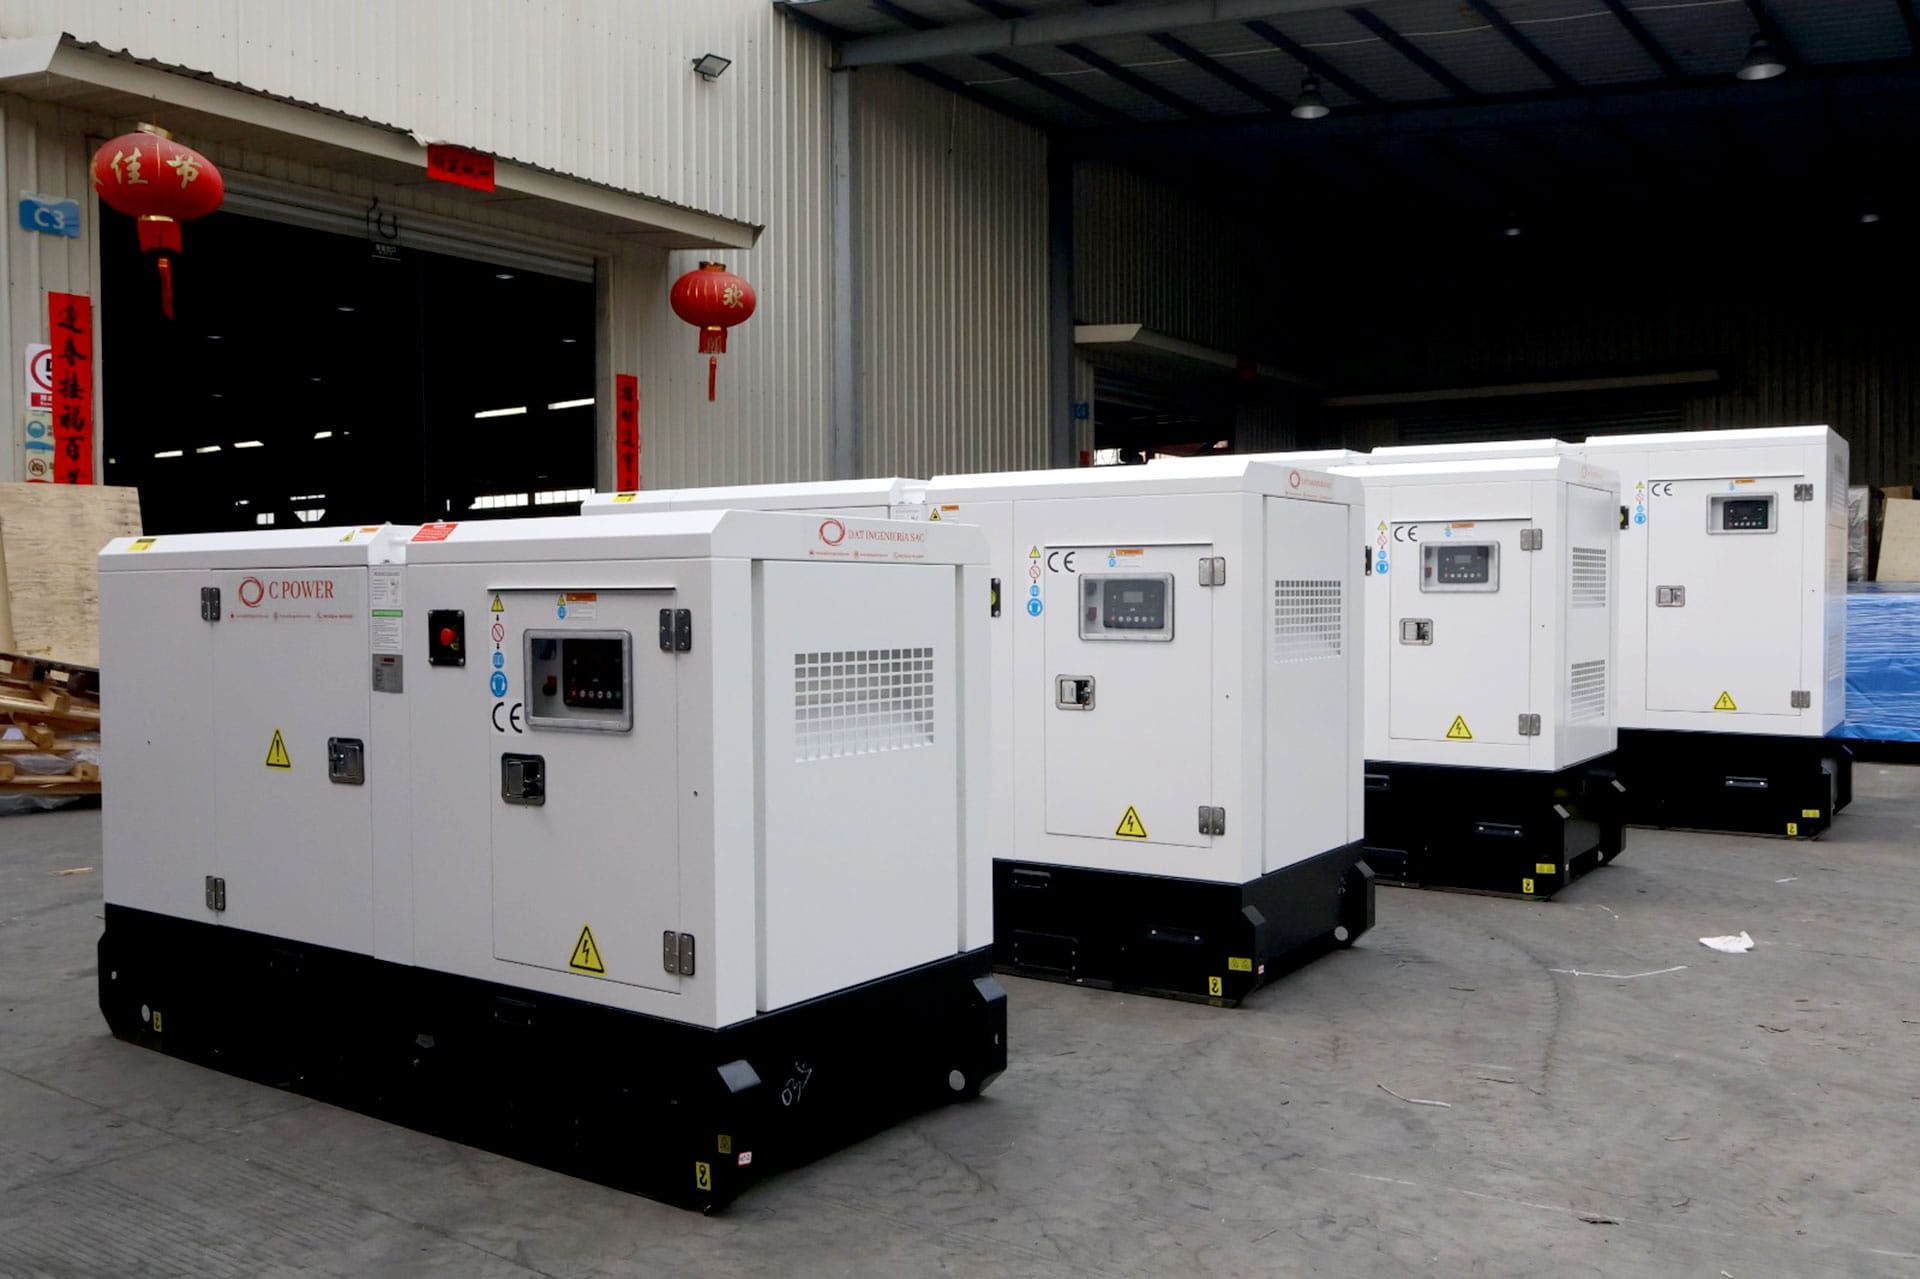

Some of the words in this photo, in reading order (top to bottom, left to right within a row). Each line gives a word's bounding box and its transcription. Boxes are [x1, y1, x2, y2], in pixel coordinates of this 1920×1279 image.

[34, 208, 64, 229] C3
[1651, 483, 1672, 496] CE
[1394, 525, 1418, 542] CE
[1047, 551, 1076, 573] CE
[269, 581, 279, 599] C
[282, 580, 334, 599] POWER
[492, 702, 523, 733] CE
